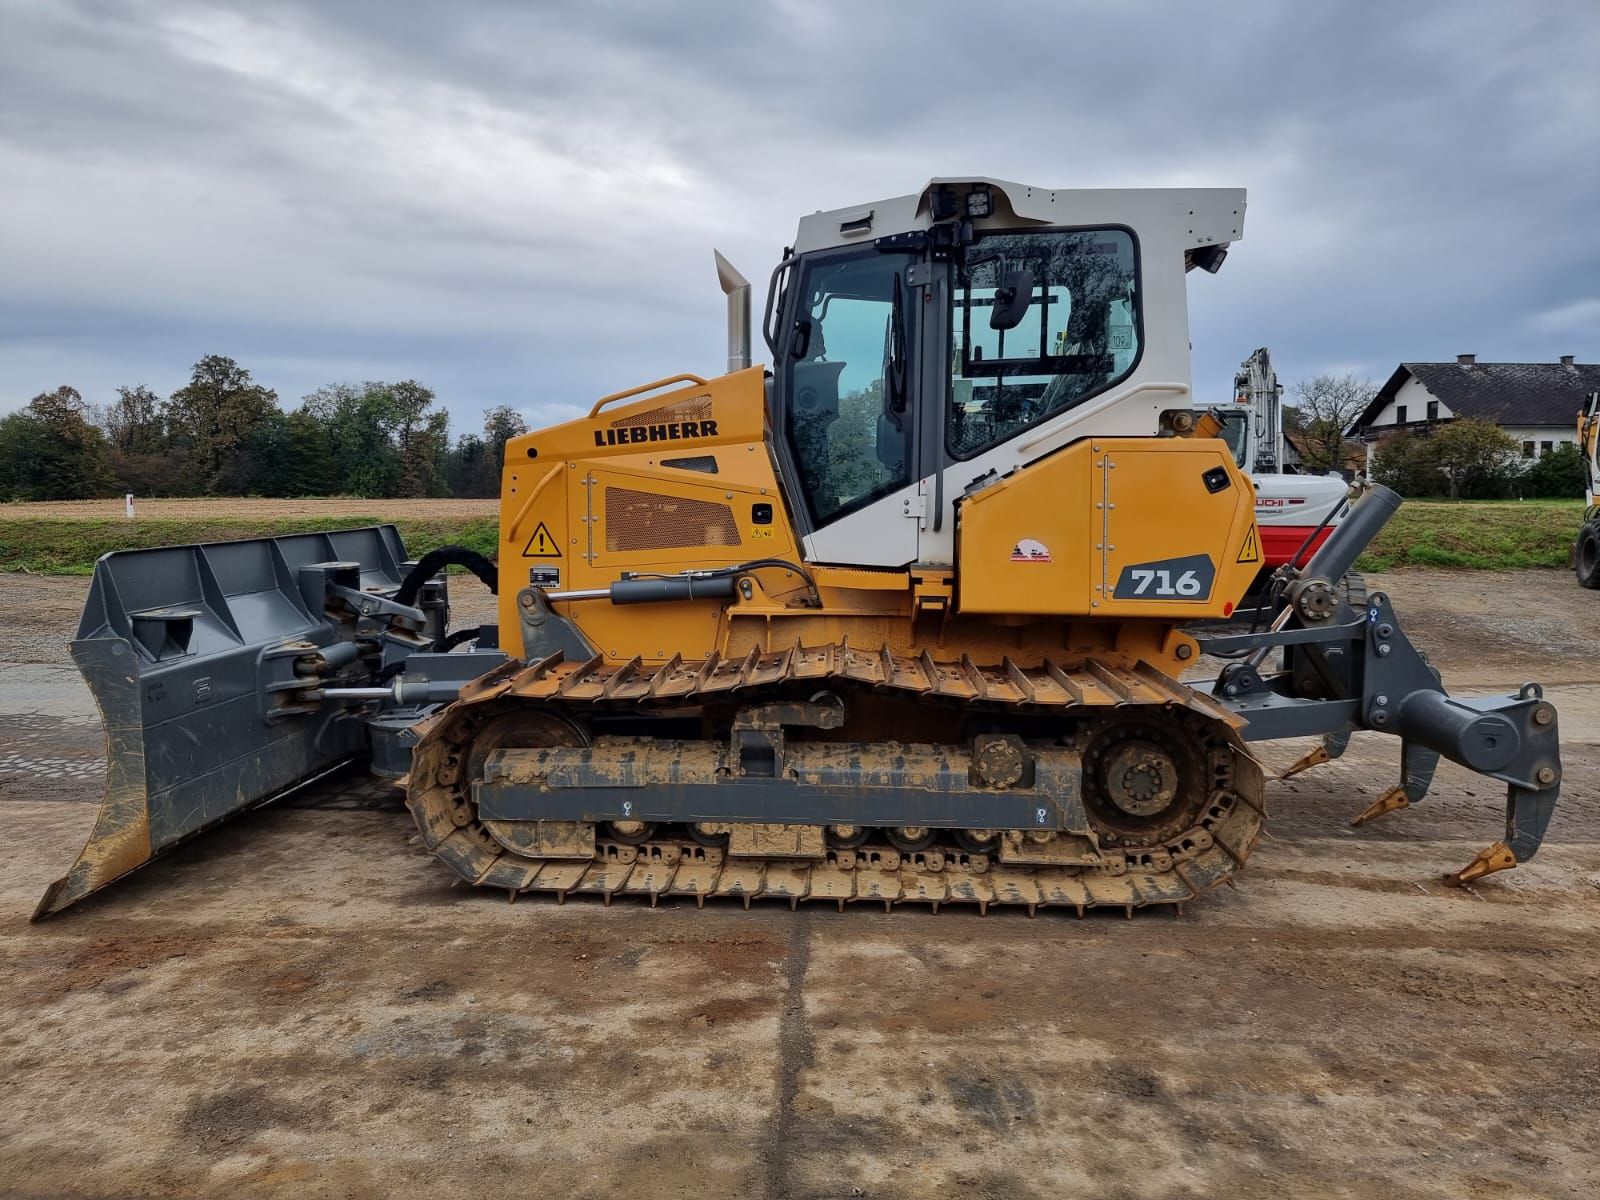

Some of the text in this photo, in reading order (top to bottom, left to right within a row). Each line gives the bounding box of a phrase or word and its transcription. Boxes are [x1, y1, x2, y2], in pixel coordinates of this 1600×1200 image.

[593, 419, 719, 447] LIEBHERR
[1255, 499, 1284, 507] UCHI
[1131, 569, 1201, 596] 716
